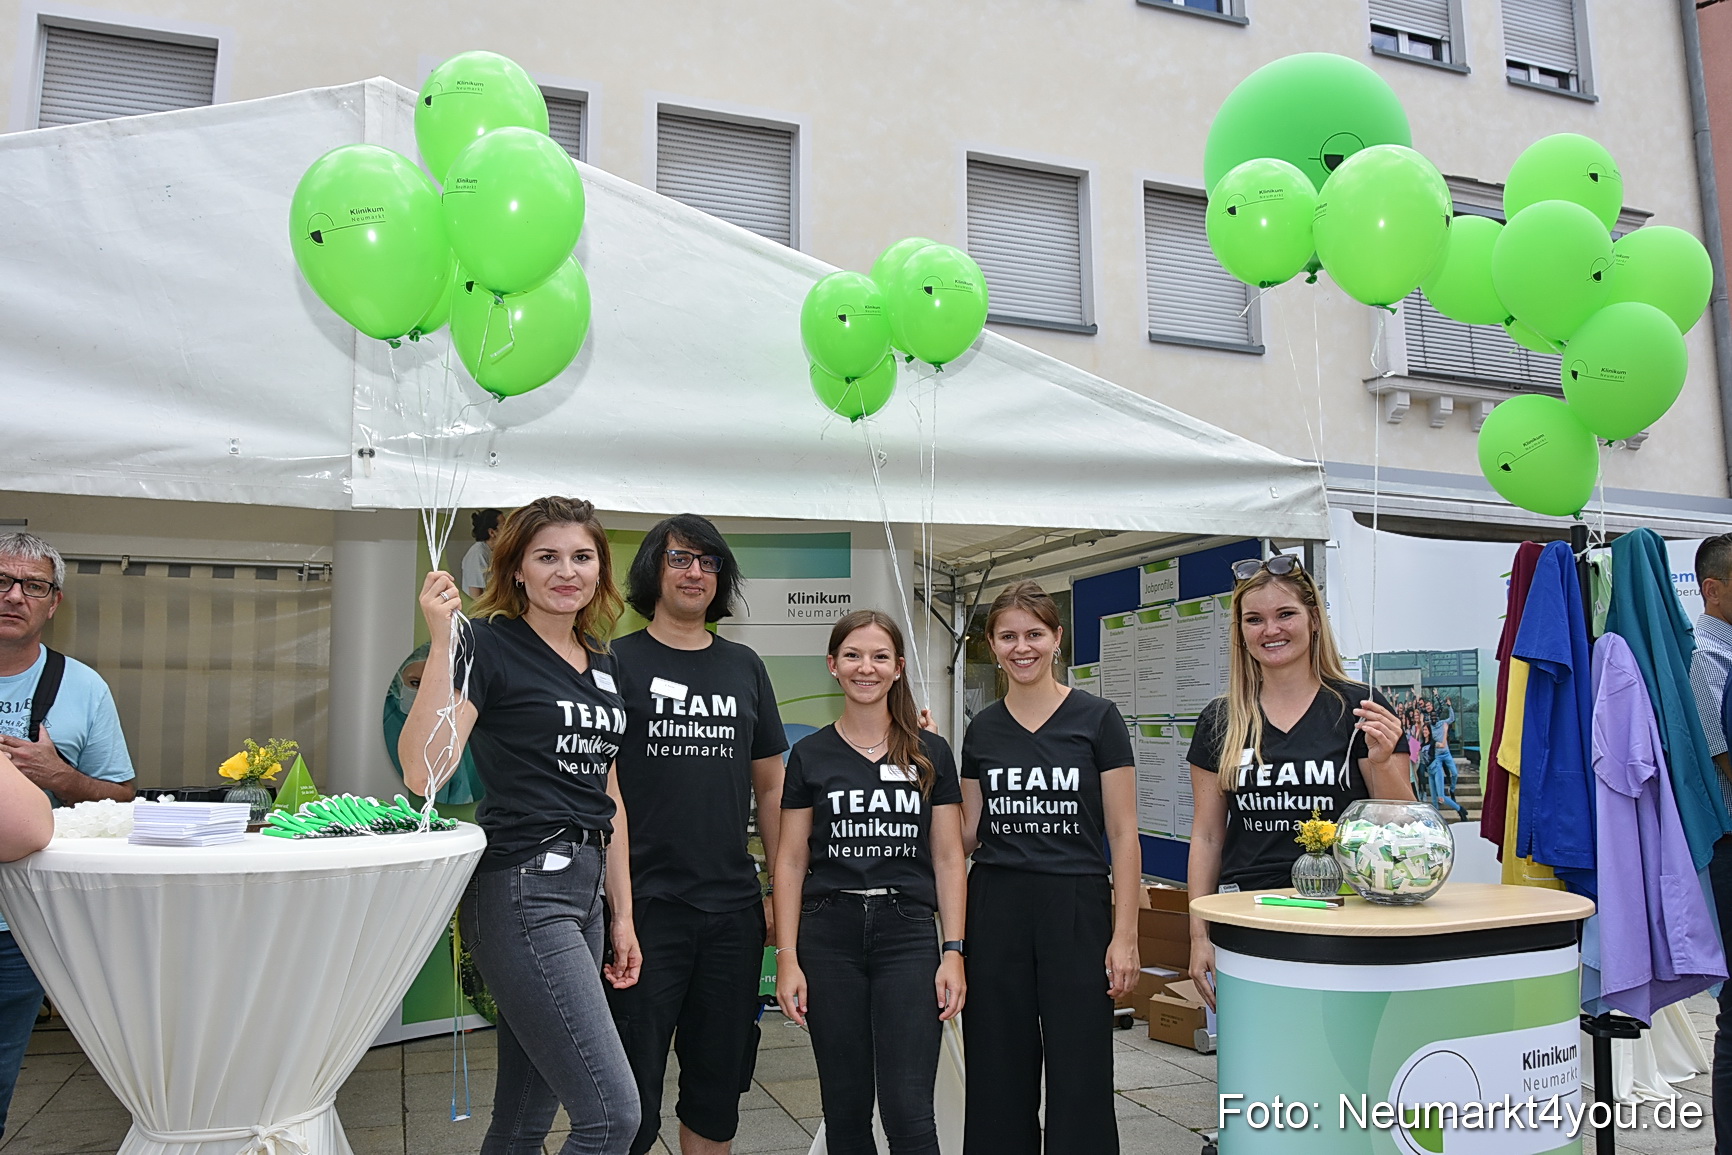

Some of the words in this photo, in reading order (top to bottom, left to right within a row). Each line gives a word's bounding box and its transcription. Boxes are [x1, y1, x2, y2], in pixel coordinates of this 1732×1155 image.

[349, 206, 385, 215] Klinikum
[1144, 579, 1174, 595] Jobprofile
[787, 591, 851, 604] Klinikum
[787, 607, 851, 618] Neumarkt
[651, 693, 737, 718] TEAM
[648, 719, 735, 740] Klinikum
[646, 743, 734, 759] Neumarkt
[987, 767, 1080, 792] TEAM
[1237, 760, 1335, 787] TEAM
[827, 789, 921, 815] TEAM
[987, 796, 1079, 816] Klinikum
[1236, 792, 1334, 811] Klinikum
[830, 818, 919, 839] Klinikum
[990, 820, 1081, 835] Neumarkt
[1242, 817, 1334, 833] Neuma
[828, 843, 917, 858] Neumarkt
[1522, 1044, 1578, 1071] Klinikum
[1523, 1066, 1578, 1092] Neumarkt
